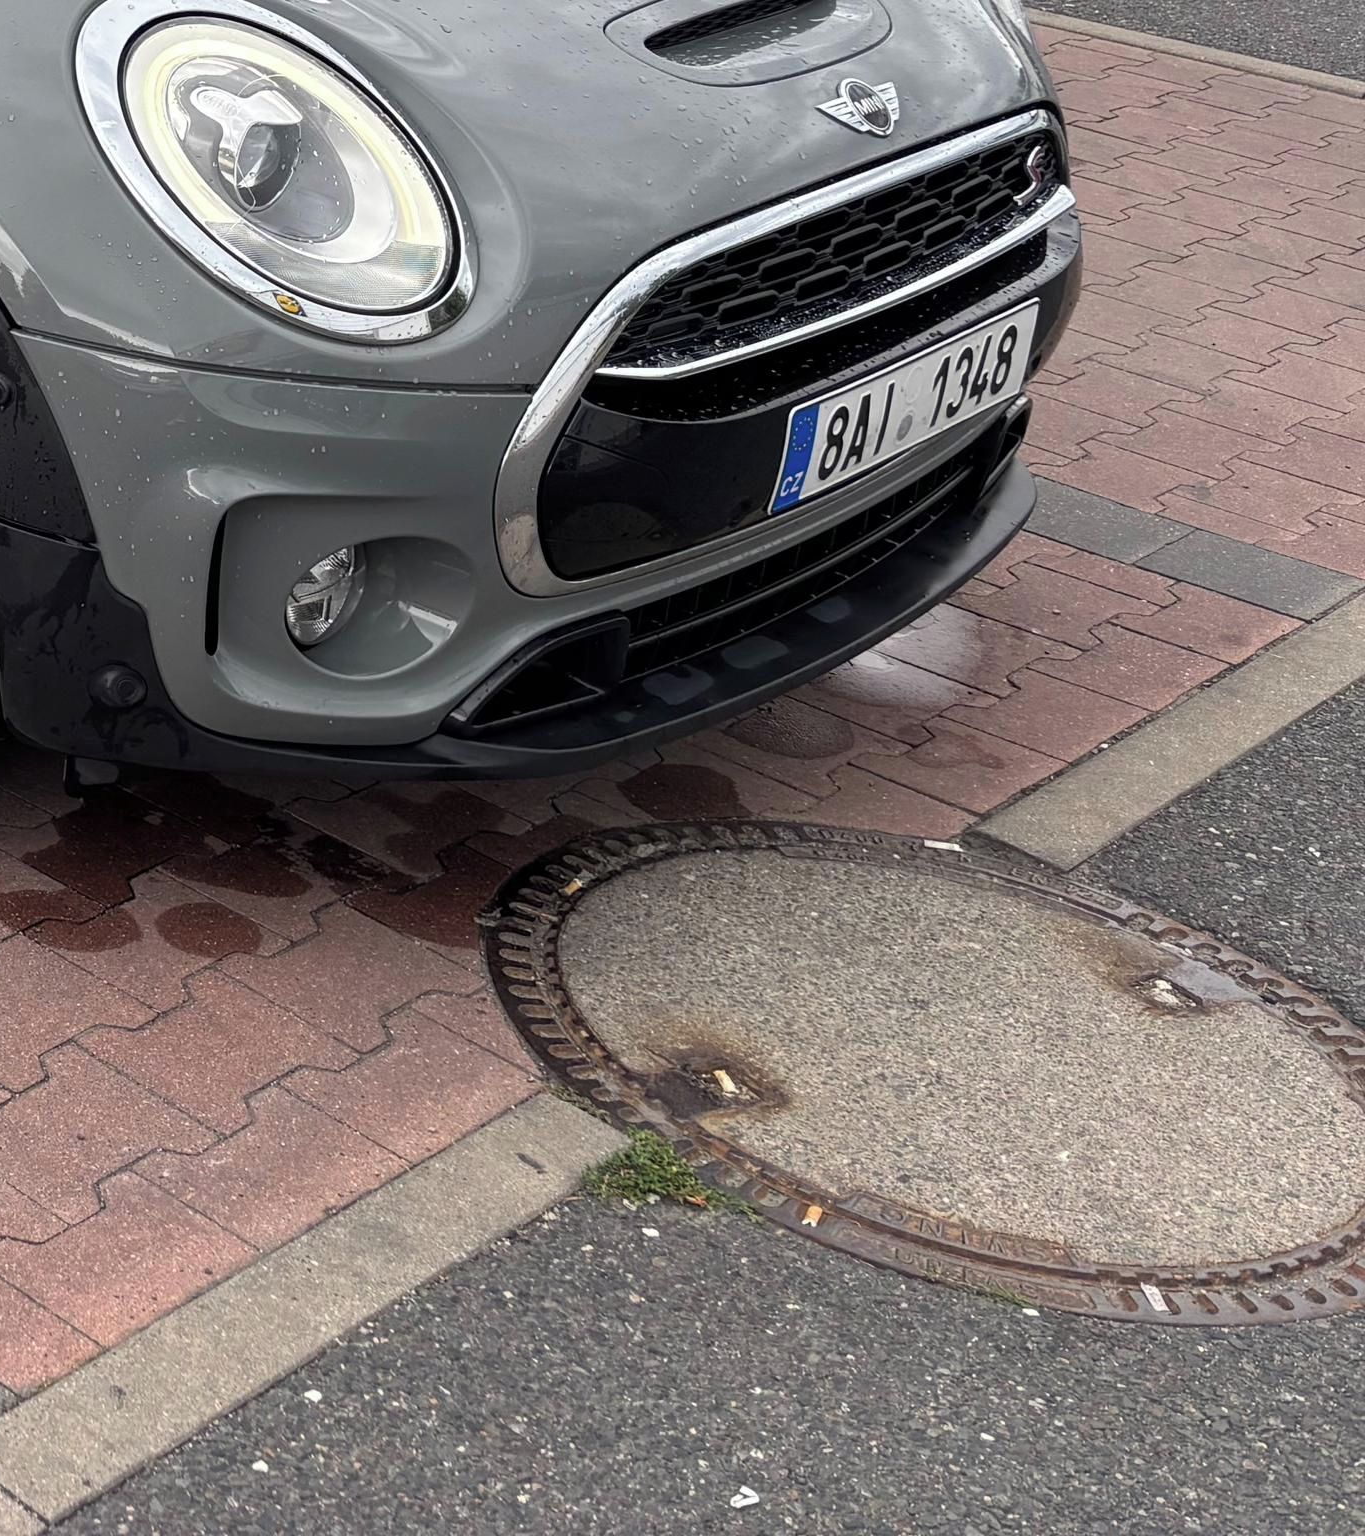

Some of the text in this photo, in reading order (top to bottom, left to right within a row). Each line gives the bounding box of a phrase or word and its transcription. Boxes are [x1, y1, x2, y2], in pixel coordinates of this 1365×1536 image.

[853, 93, 885, 116] MINI
[818, 324, 1018, 481] 8AI 1348
[780, 471, 804, 498] CZ
